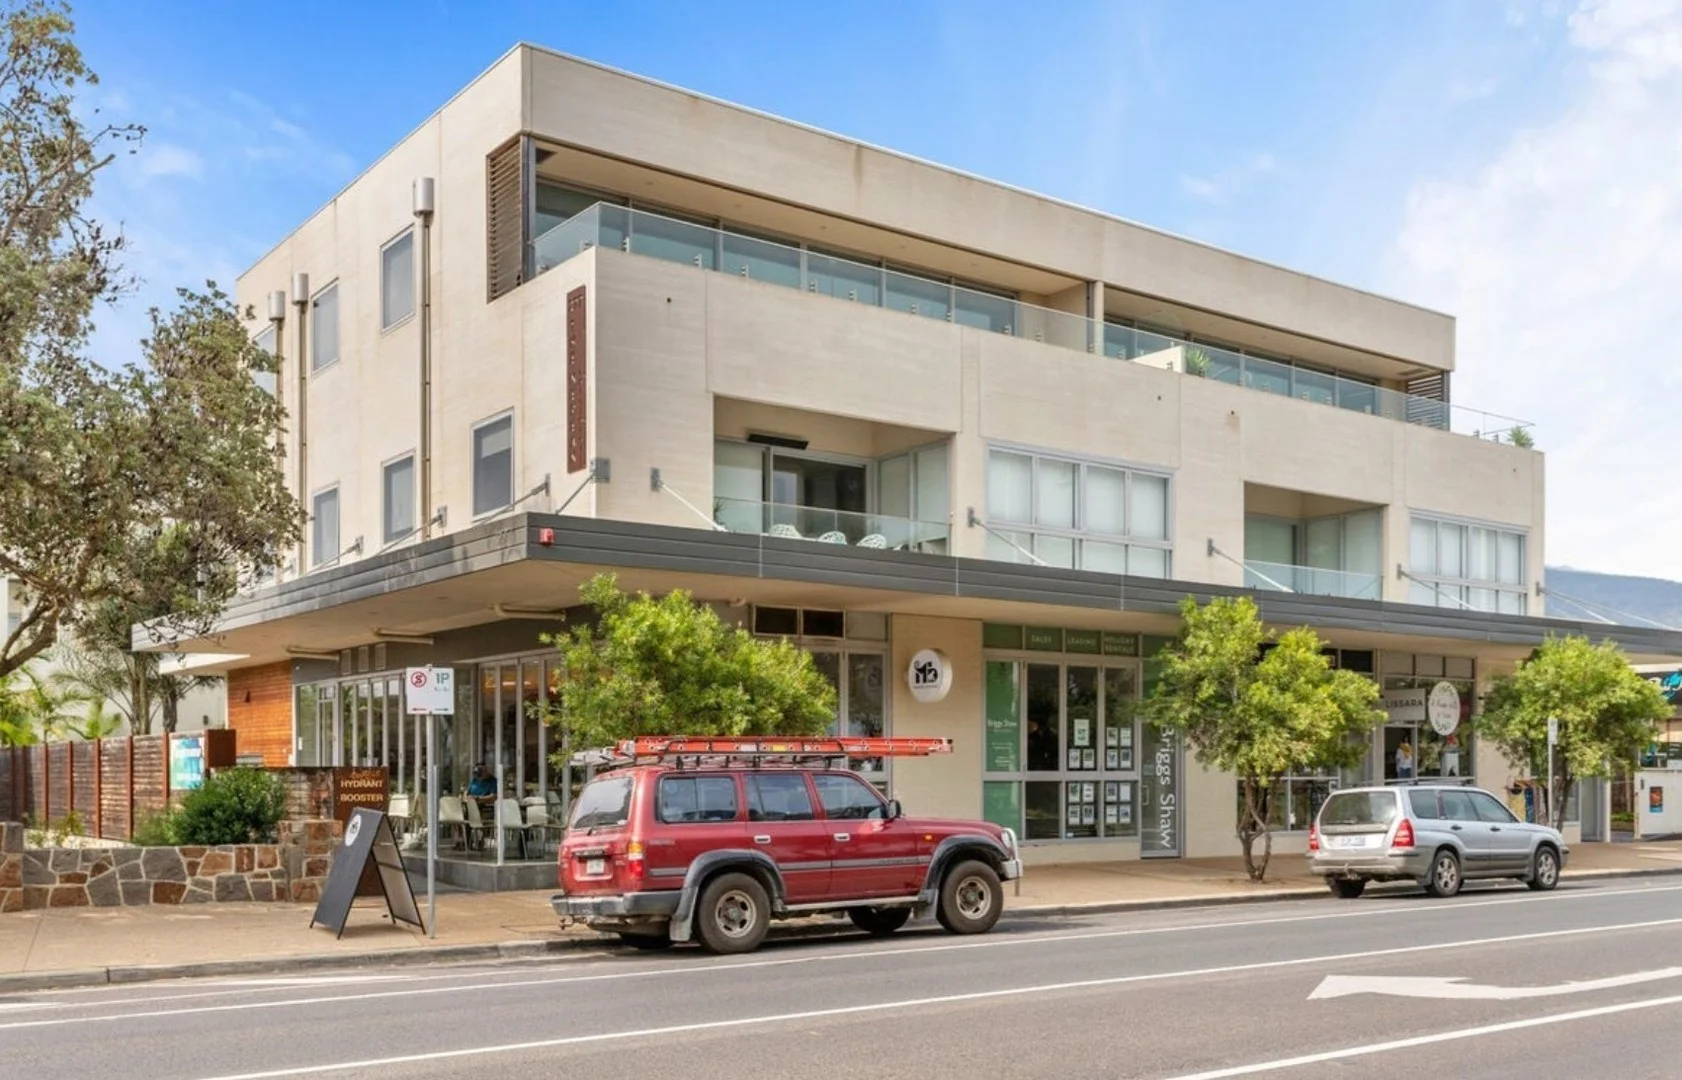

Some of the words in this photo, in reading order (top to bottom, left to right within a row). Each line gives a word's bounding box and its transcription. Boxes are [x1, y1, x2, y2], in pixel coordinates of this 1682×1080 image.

[1155, 724, 1175, 785] Briggs
[340, 779, 383, 788] HYDRANT
[340, 793, 384, 802] BOOSTER
[1160, 793, 1175, 848] Shaw
